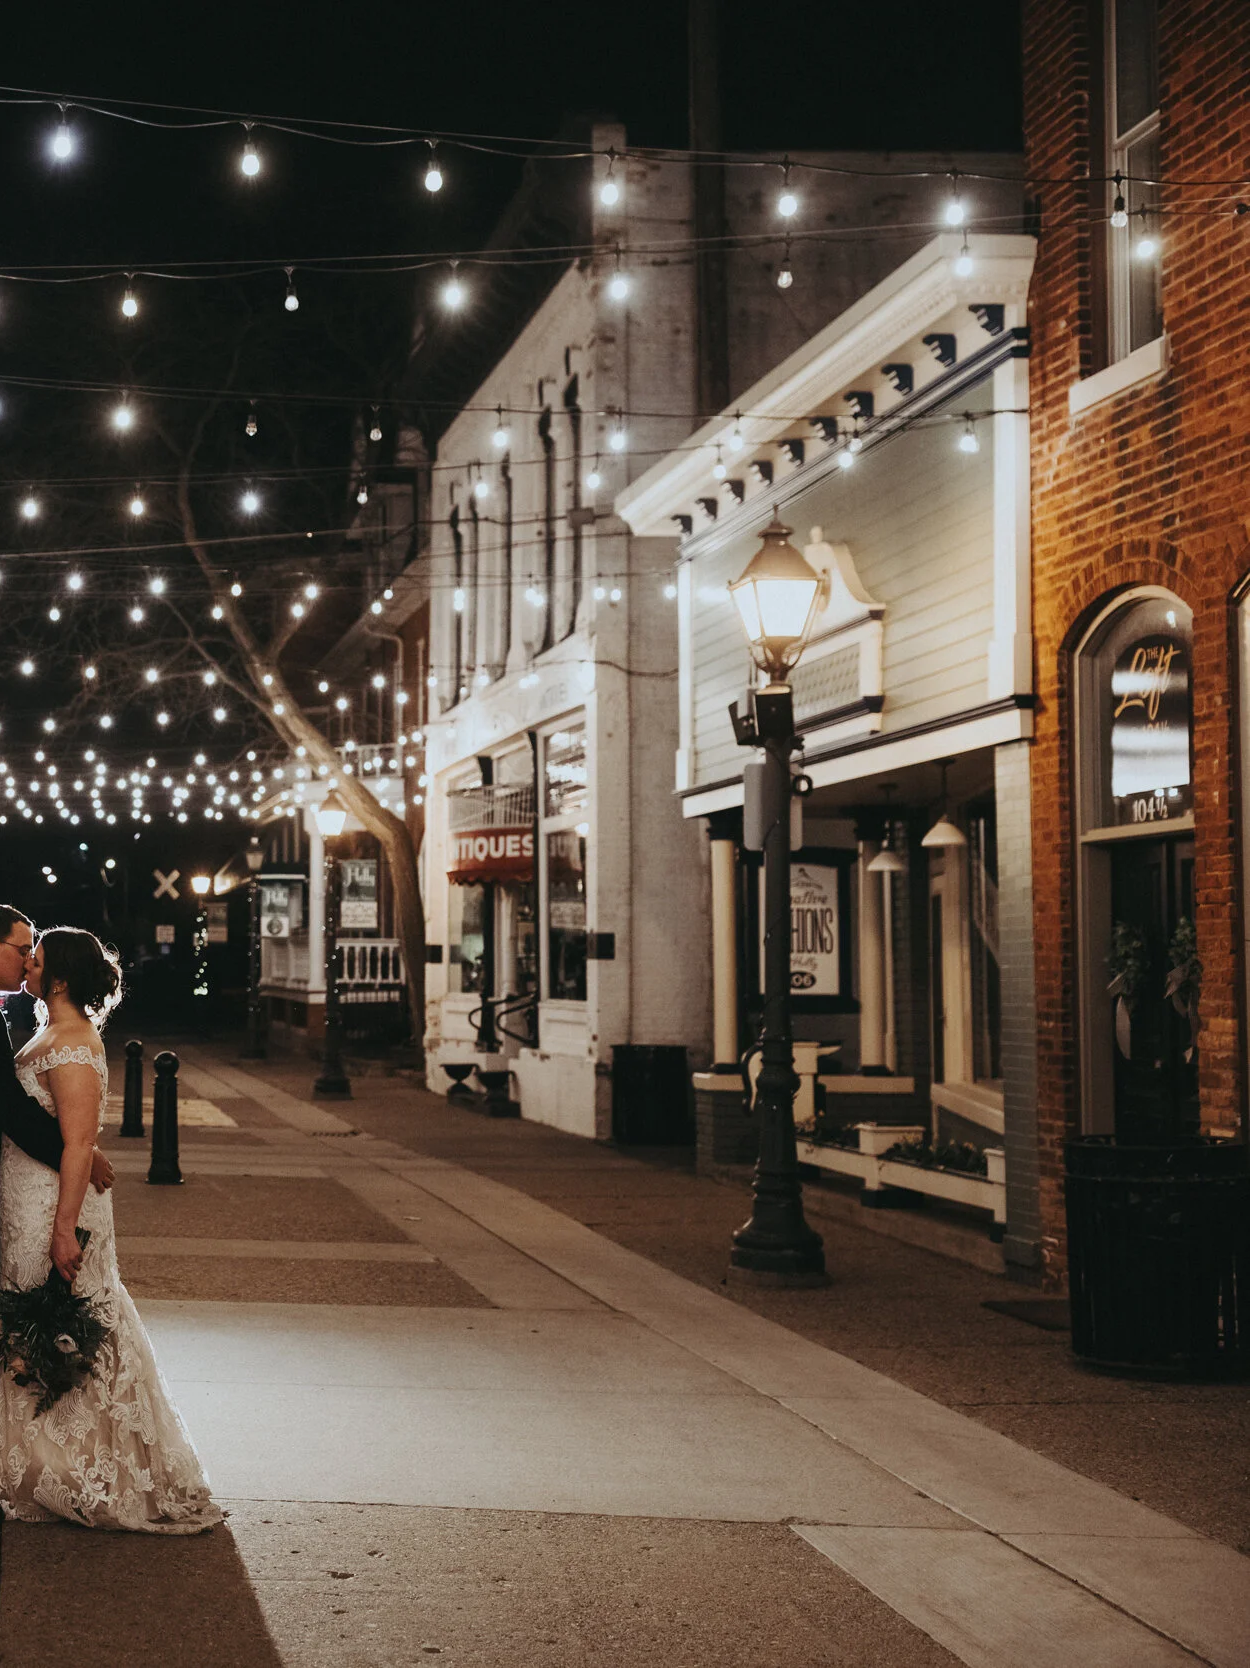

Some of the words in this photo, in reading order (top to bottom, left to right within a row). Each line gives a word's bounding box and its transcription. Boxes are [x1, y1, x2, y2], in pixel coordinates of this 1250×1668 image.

[1146, 646, 1159, 660] THE
[1114, 643, 1182, 720] Loft
[790, 890, 828, 905] ative
[790, 907, 834, 954] HIONS
[791, 972, 813, 988] 06
